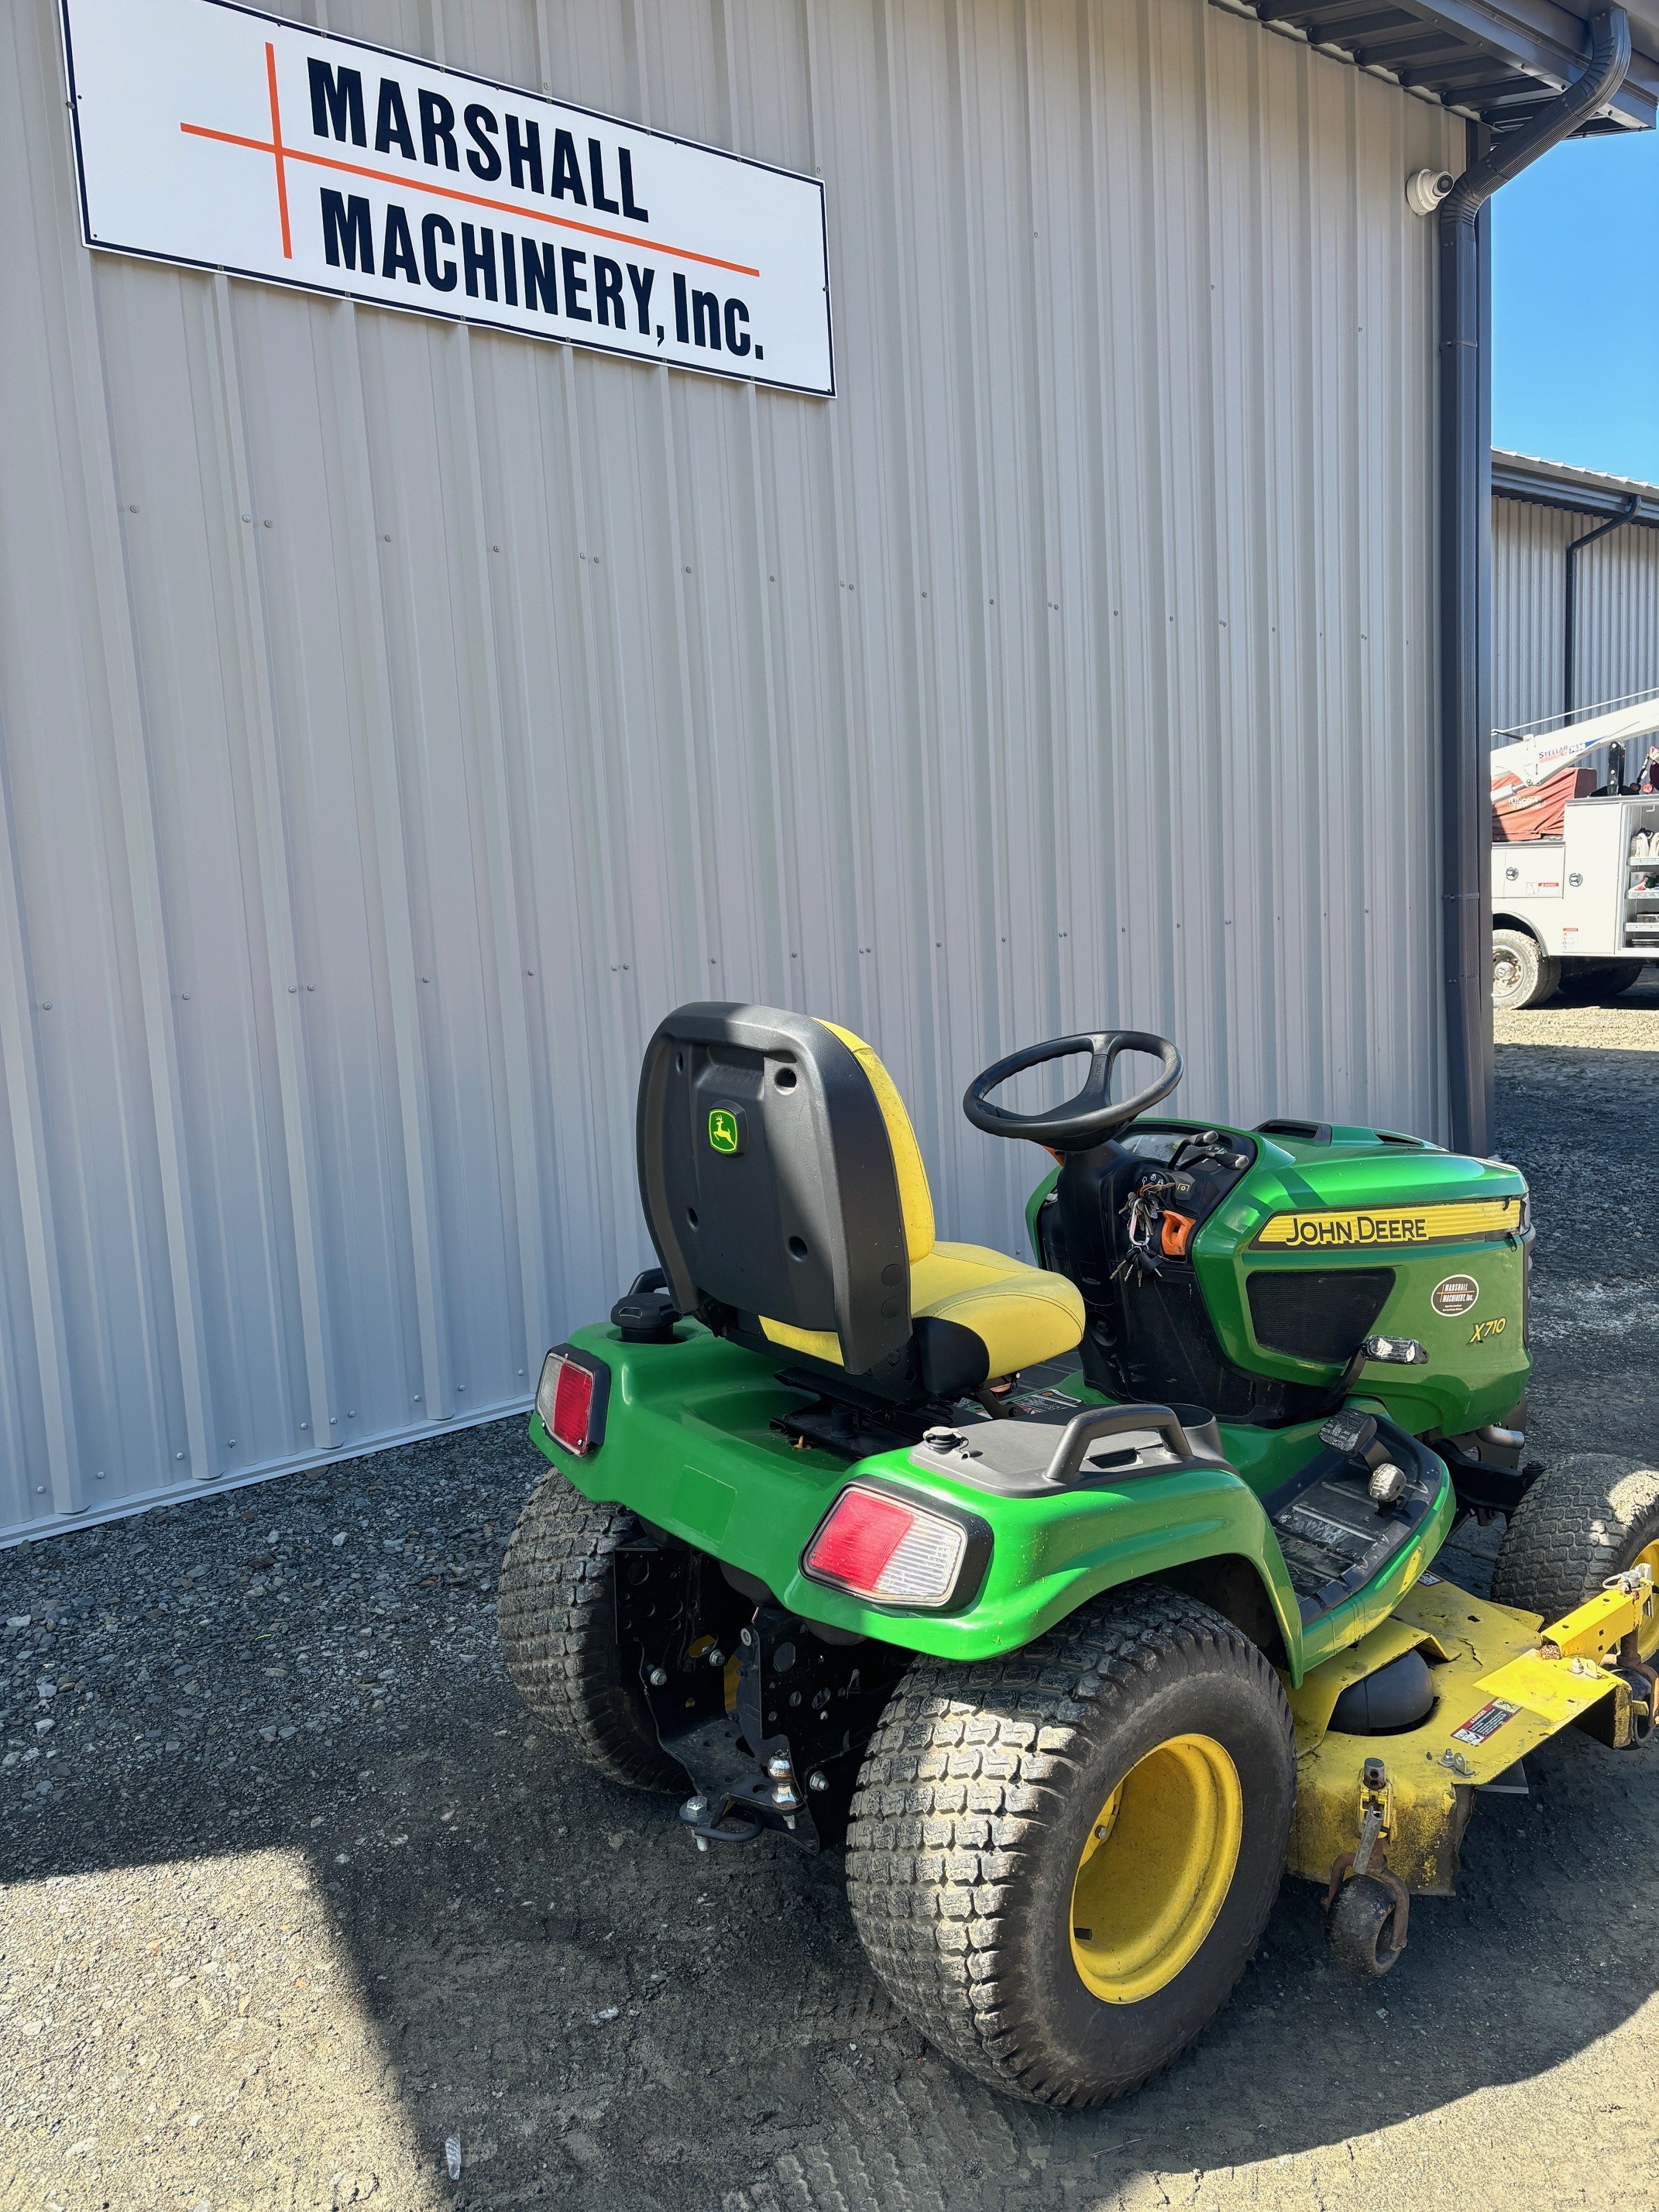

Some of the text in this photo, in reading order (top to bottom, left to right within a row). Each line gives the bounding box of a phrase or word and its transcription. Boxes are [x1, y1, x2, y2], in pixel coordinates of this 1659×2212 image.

[307, 57, 649, 223] MARSHALL
[673, 273, 764, 361] Inc.
[1286, 1217, 1427, 1242] JOHN DEERE
[1444, 1283, 1468, 1292] MARSHALL
[1469, 1317, 1506, 1343] X710
